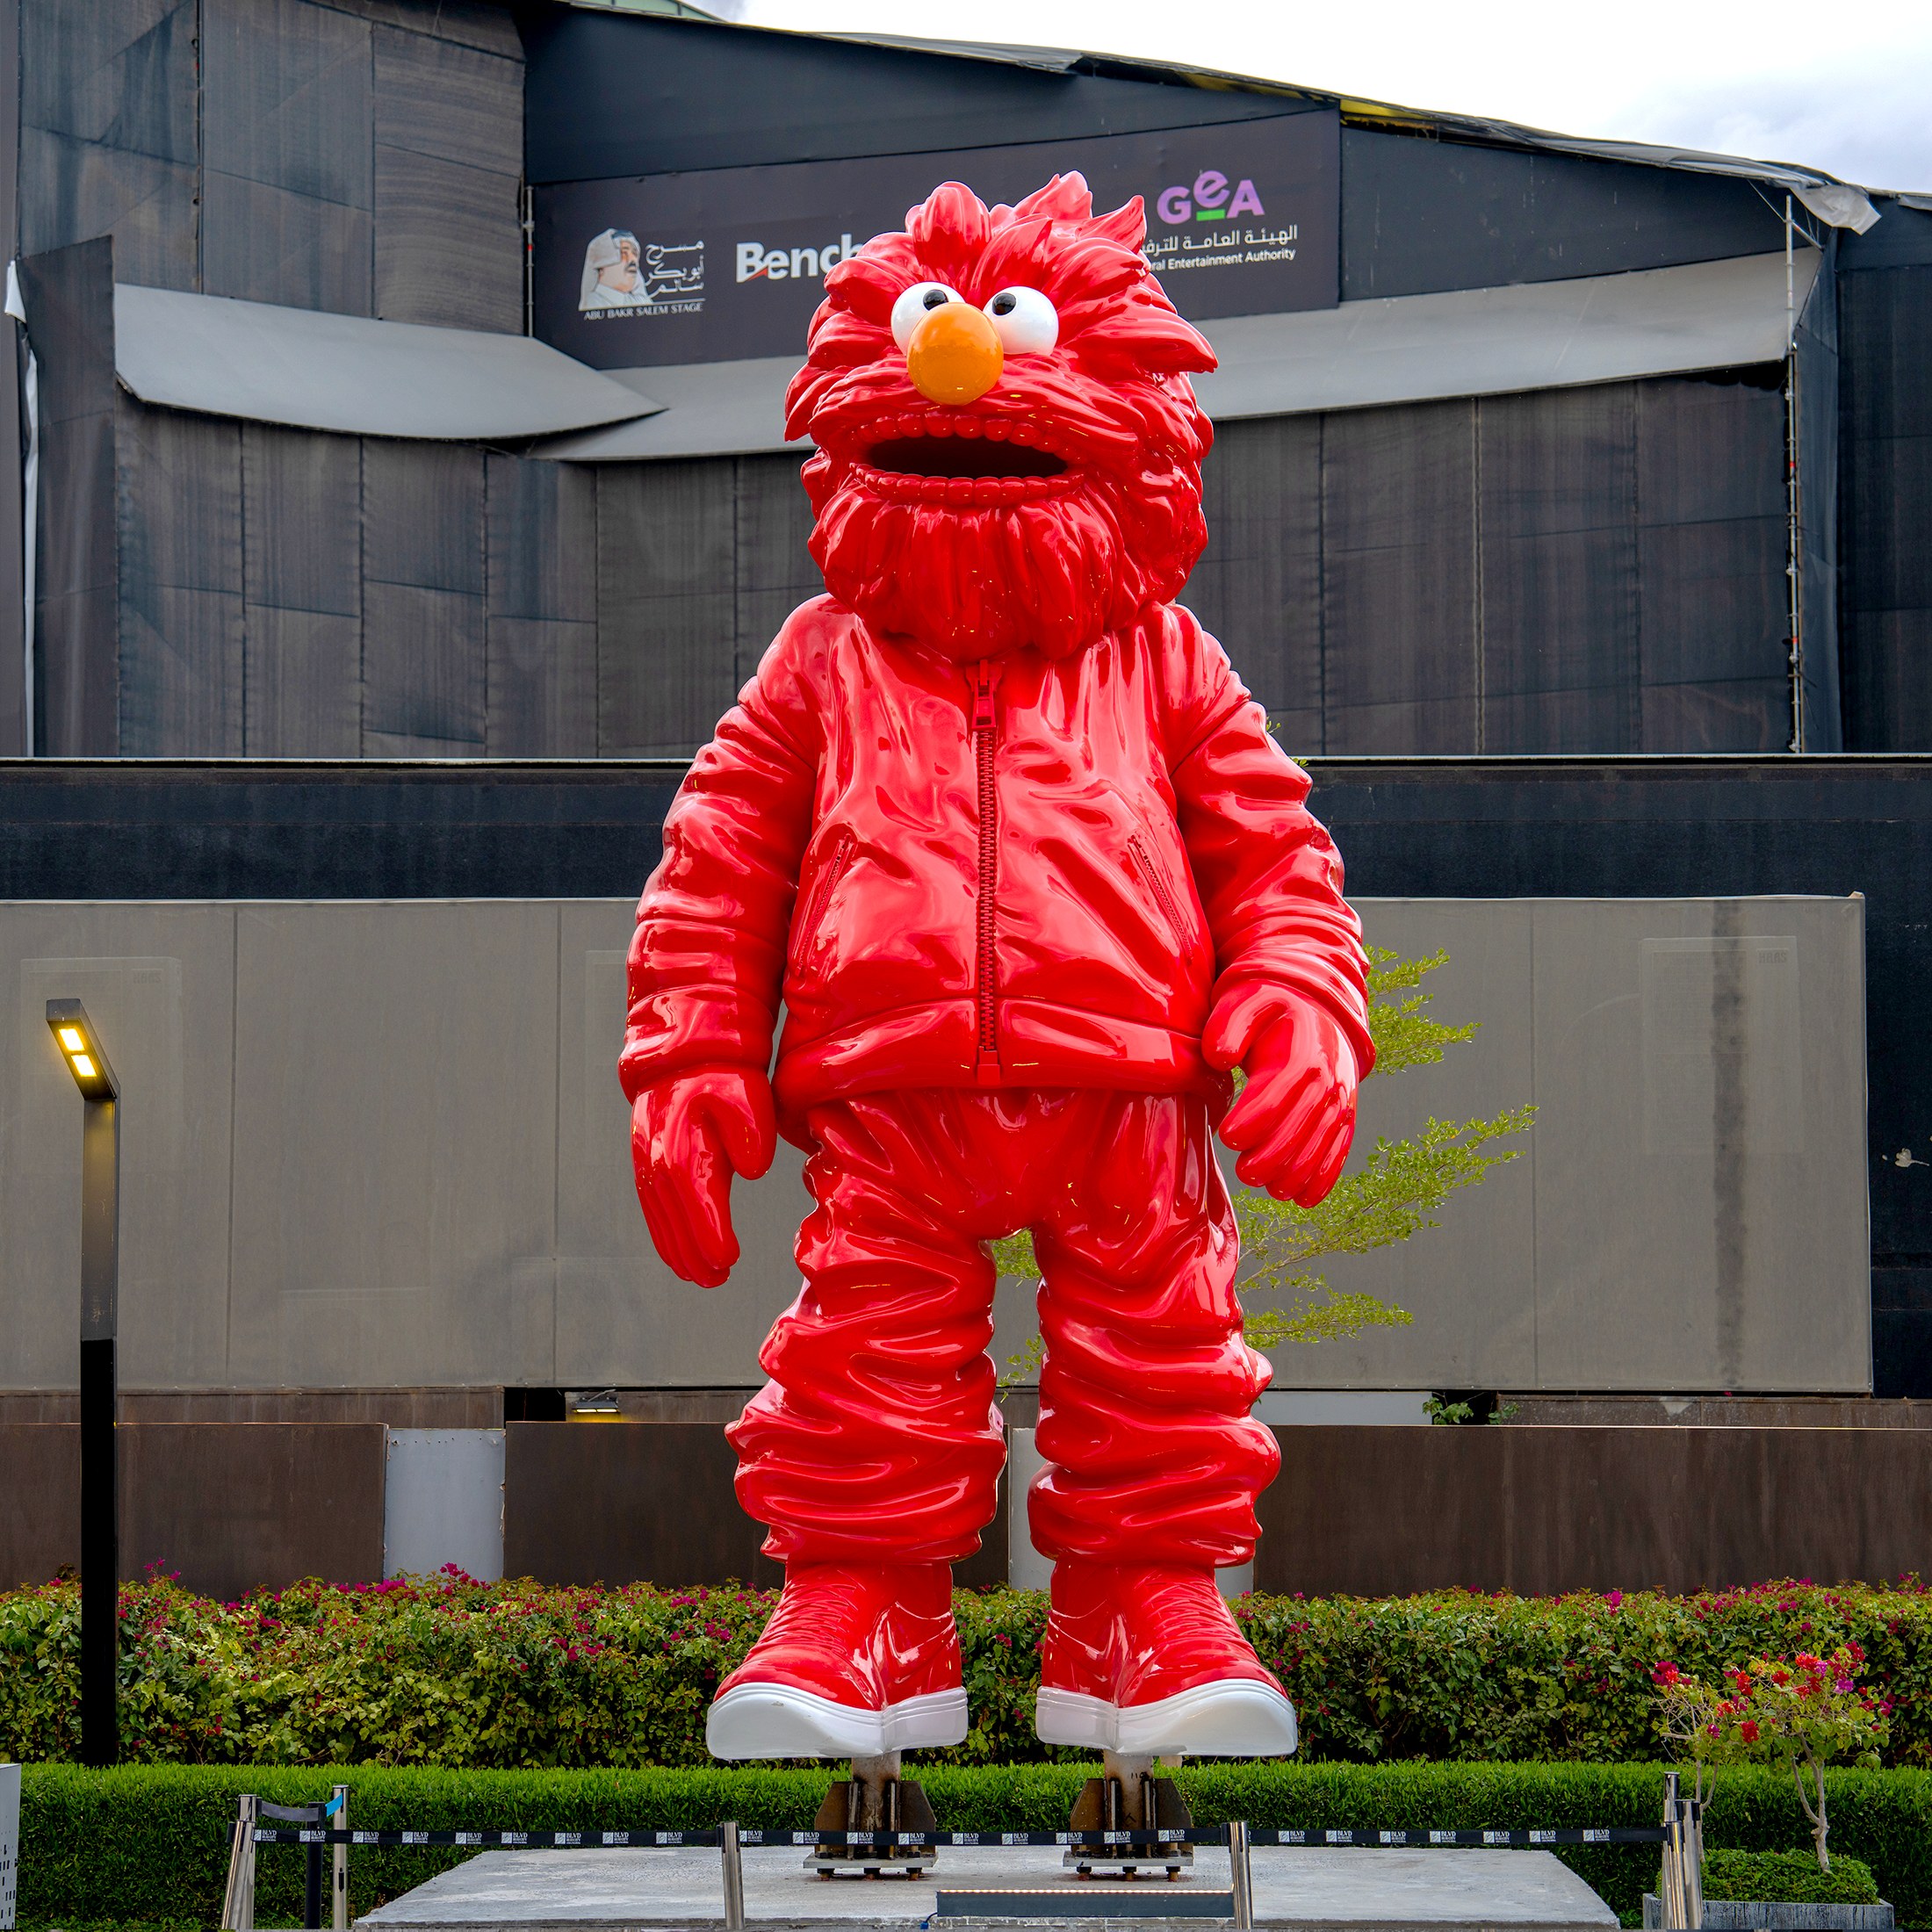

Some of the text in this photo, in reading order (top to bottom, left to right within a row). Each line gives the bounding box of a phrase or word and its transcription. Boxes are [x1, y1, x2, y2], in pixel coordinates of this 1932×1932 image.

[1182, 230, 1241, 250] العامة
[1244, 224, 1297, 245] الهيئة
[736, 233, 864, 283] Bench
[1167, 252, 1244, 270] Entertainment
[1245, 247, 1296, 263] Authority
[584, 302, 703, 321] ABU BAKR SALEM STAGE
